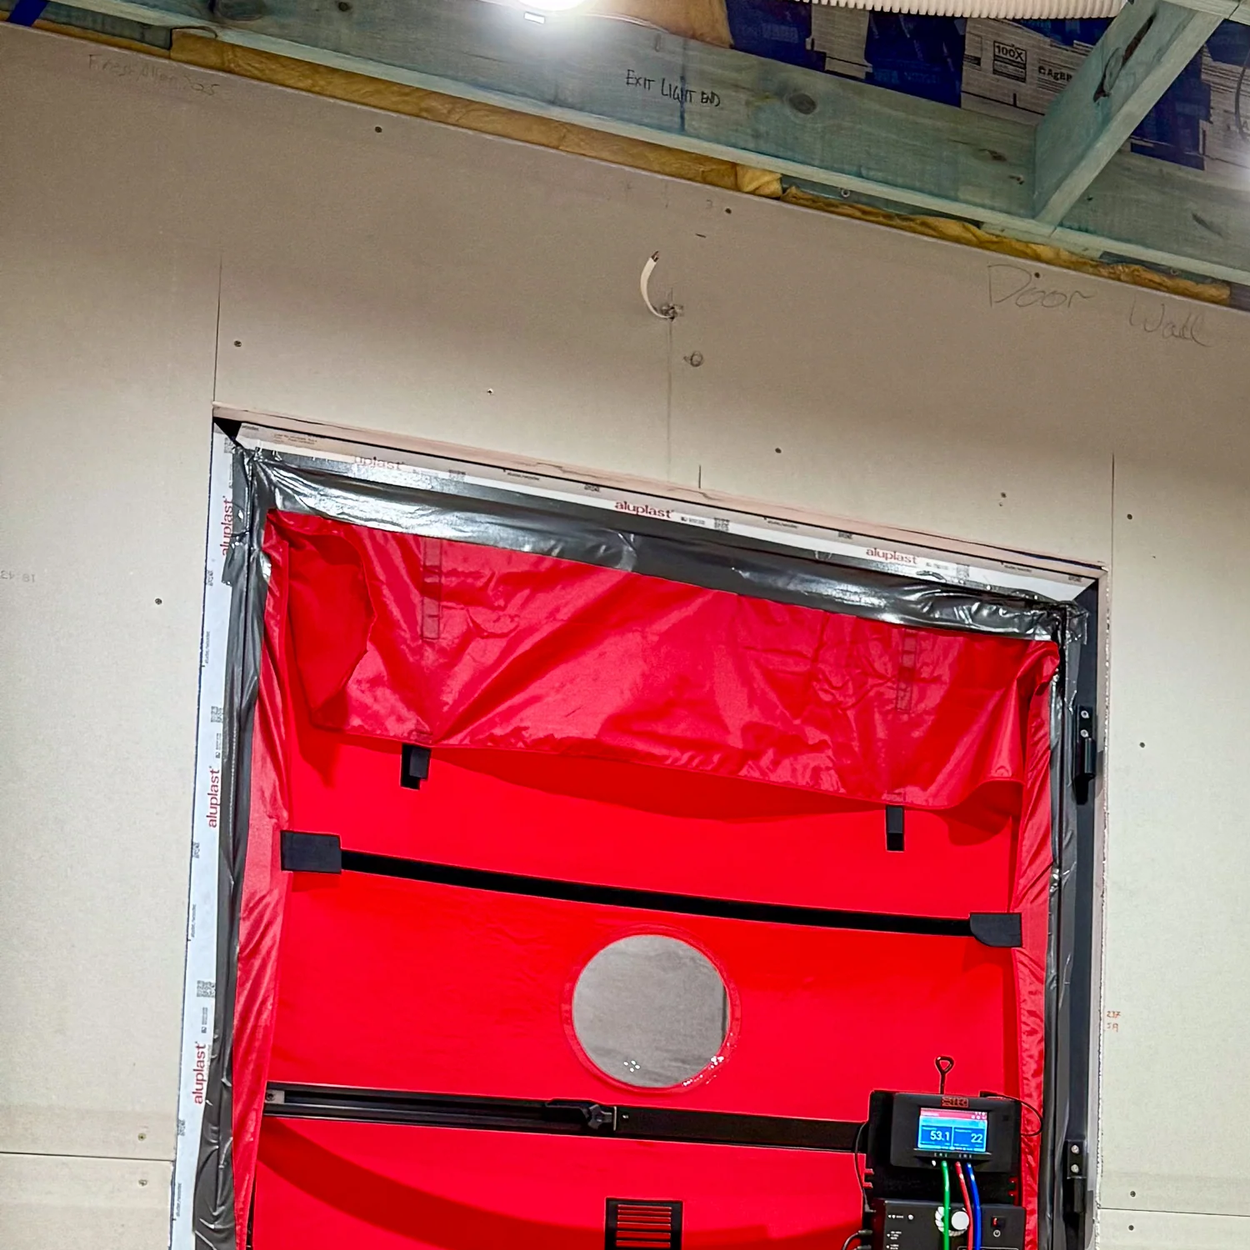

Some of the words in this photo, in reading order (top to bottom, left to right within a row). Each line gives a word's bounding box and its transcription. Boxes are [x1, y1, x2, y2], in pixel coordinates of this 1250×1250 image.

[626, 69, 656, 91] EXIT
[700, 91, 721, 107] END
[987, 263, 1097, 309] Door
[614, 500, 674, 519] aluplast
[865, 547, 918, 565] aluplast
[205, 765, 222, 829] aluplast
[192, 1041, 207, 1105] aluplast
[930, 1130, 950, 1141] 53.1
[970, 1133, 983, 1143] 22
